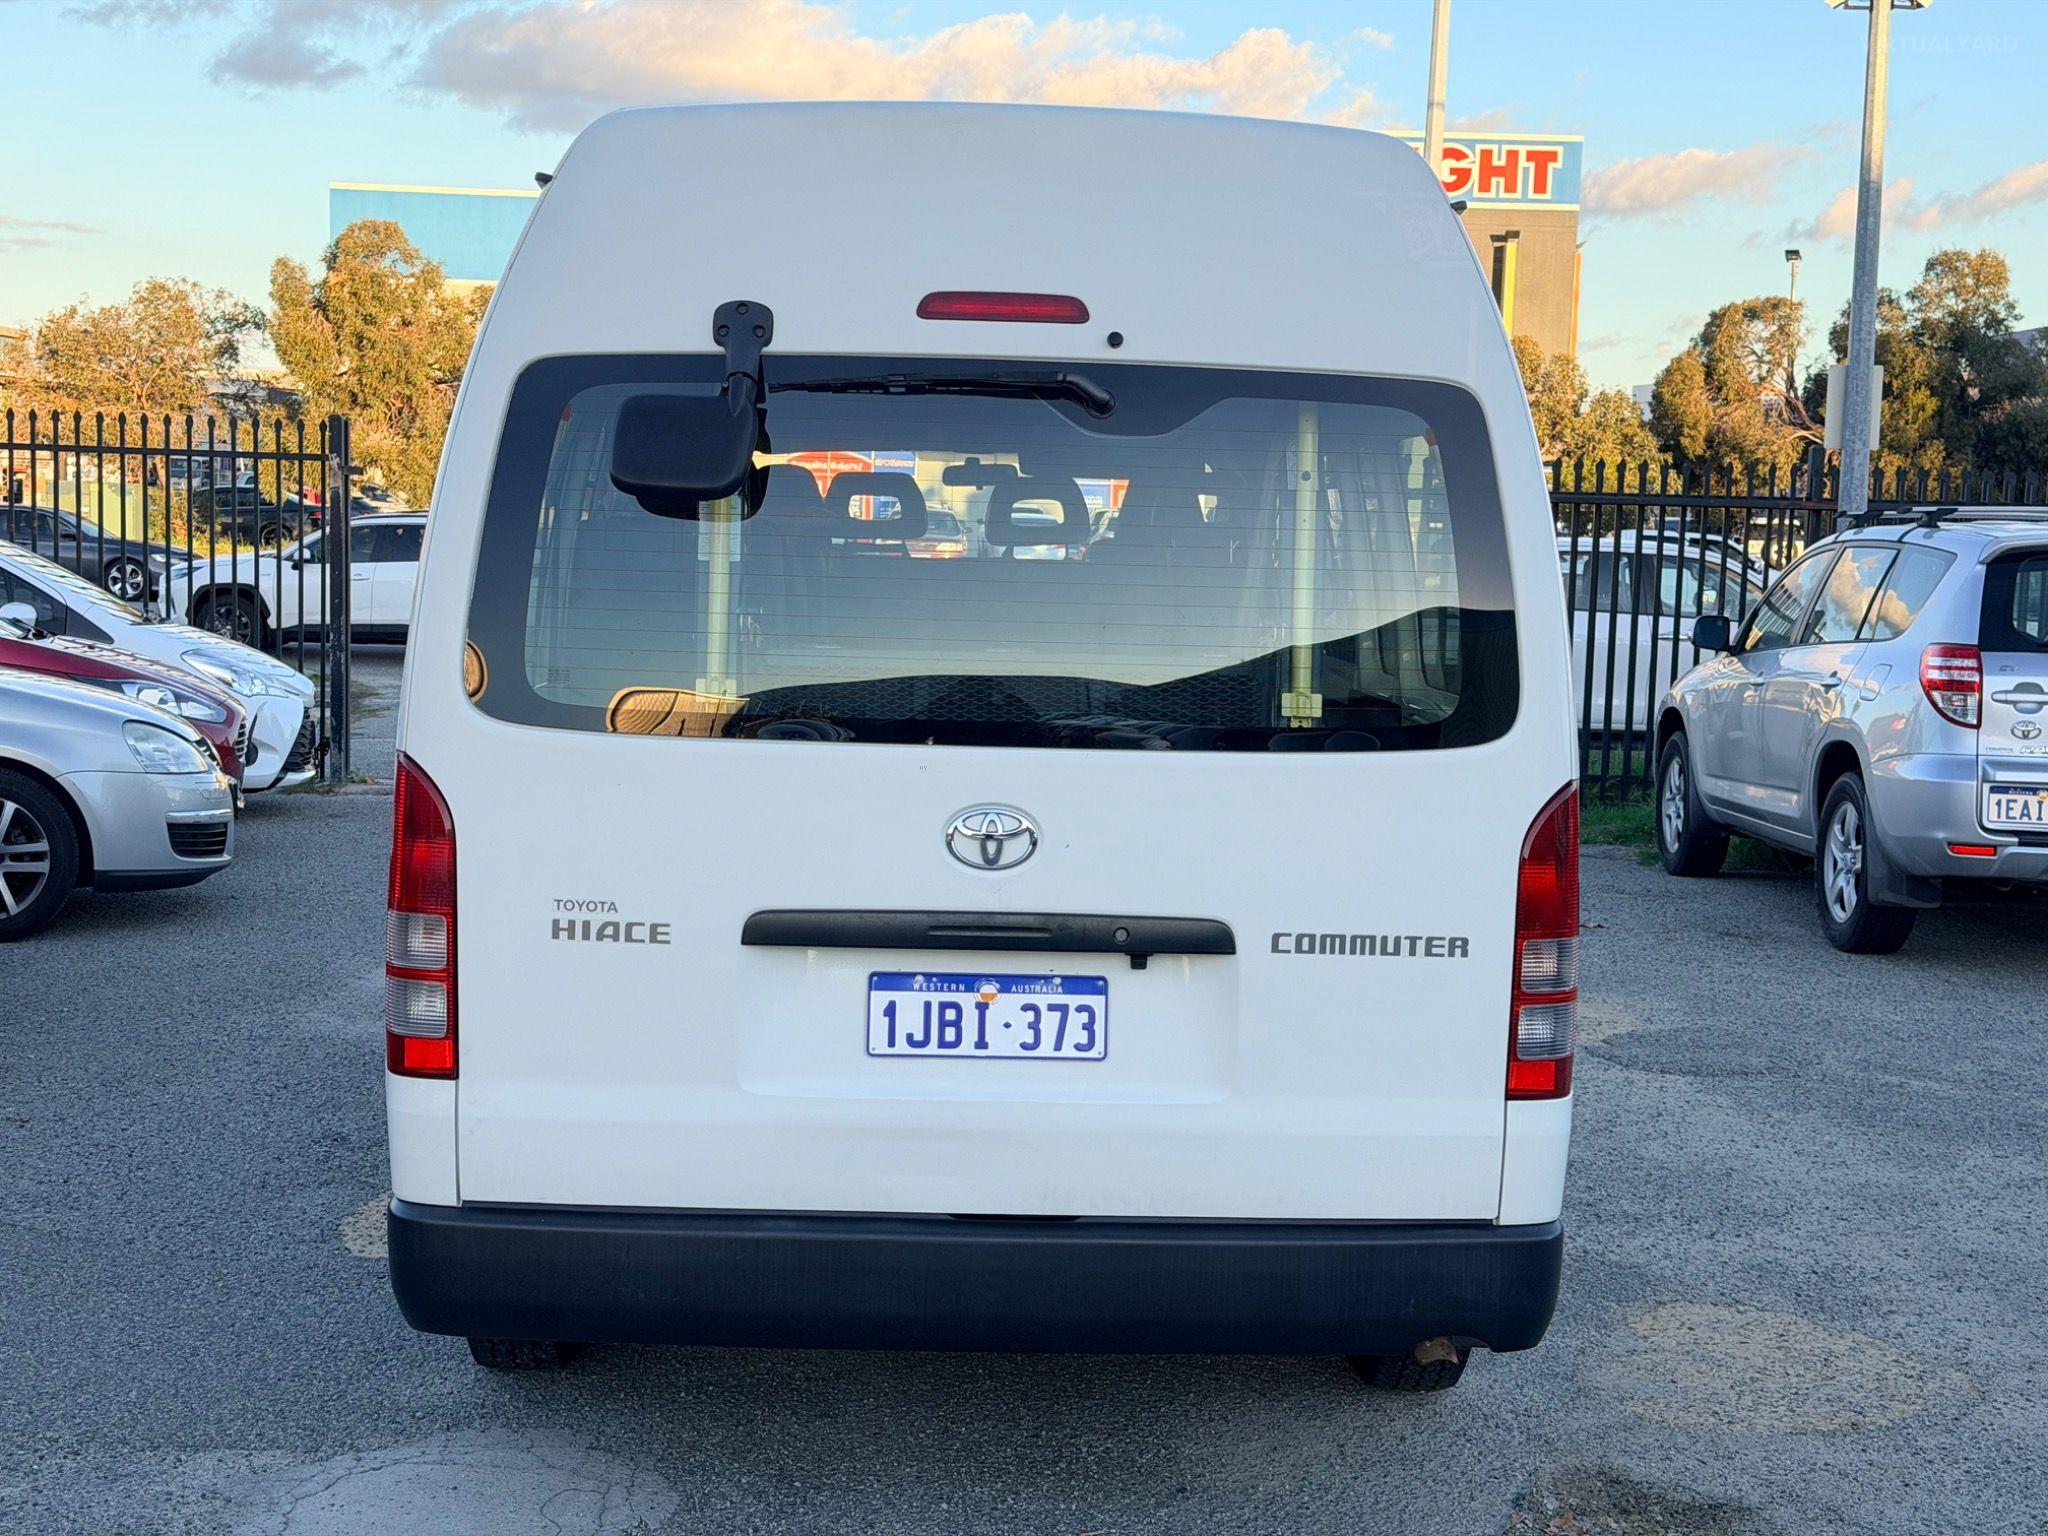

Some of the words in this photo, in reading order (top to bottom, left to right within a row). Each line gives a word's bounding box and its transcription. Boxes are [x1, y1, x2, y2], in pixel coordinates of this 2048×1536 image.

[1412, 142, 1561, 197] GHT
[1995, 798, 2044, 821] 1EAI
[553, 899, 619, 914] TOYOTA
[551, 918, 671, 945] HIACE
[1270, 932, 1470, 958] COMMUTER
[912, 982, 965, 992] WESTERN
[1010, 984, 1064, 994] AUSTRALIA
